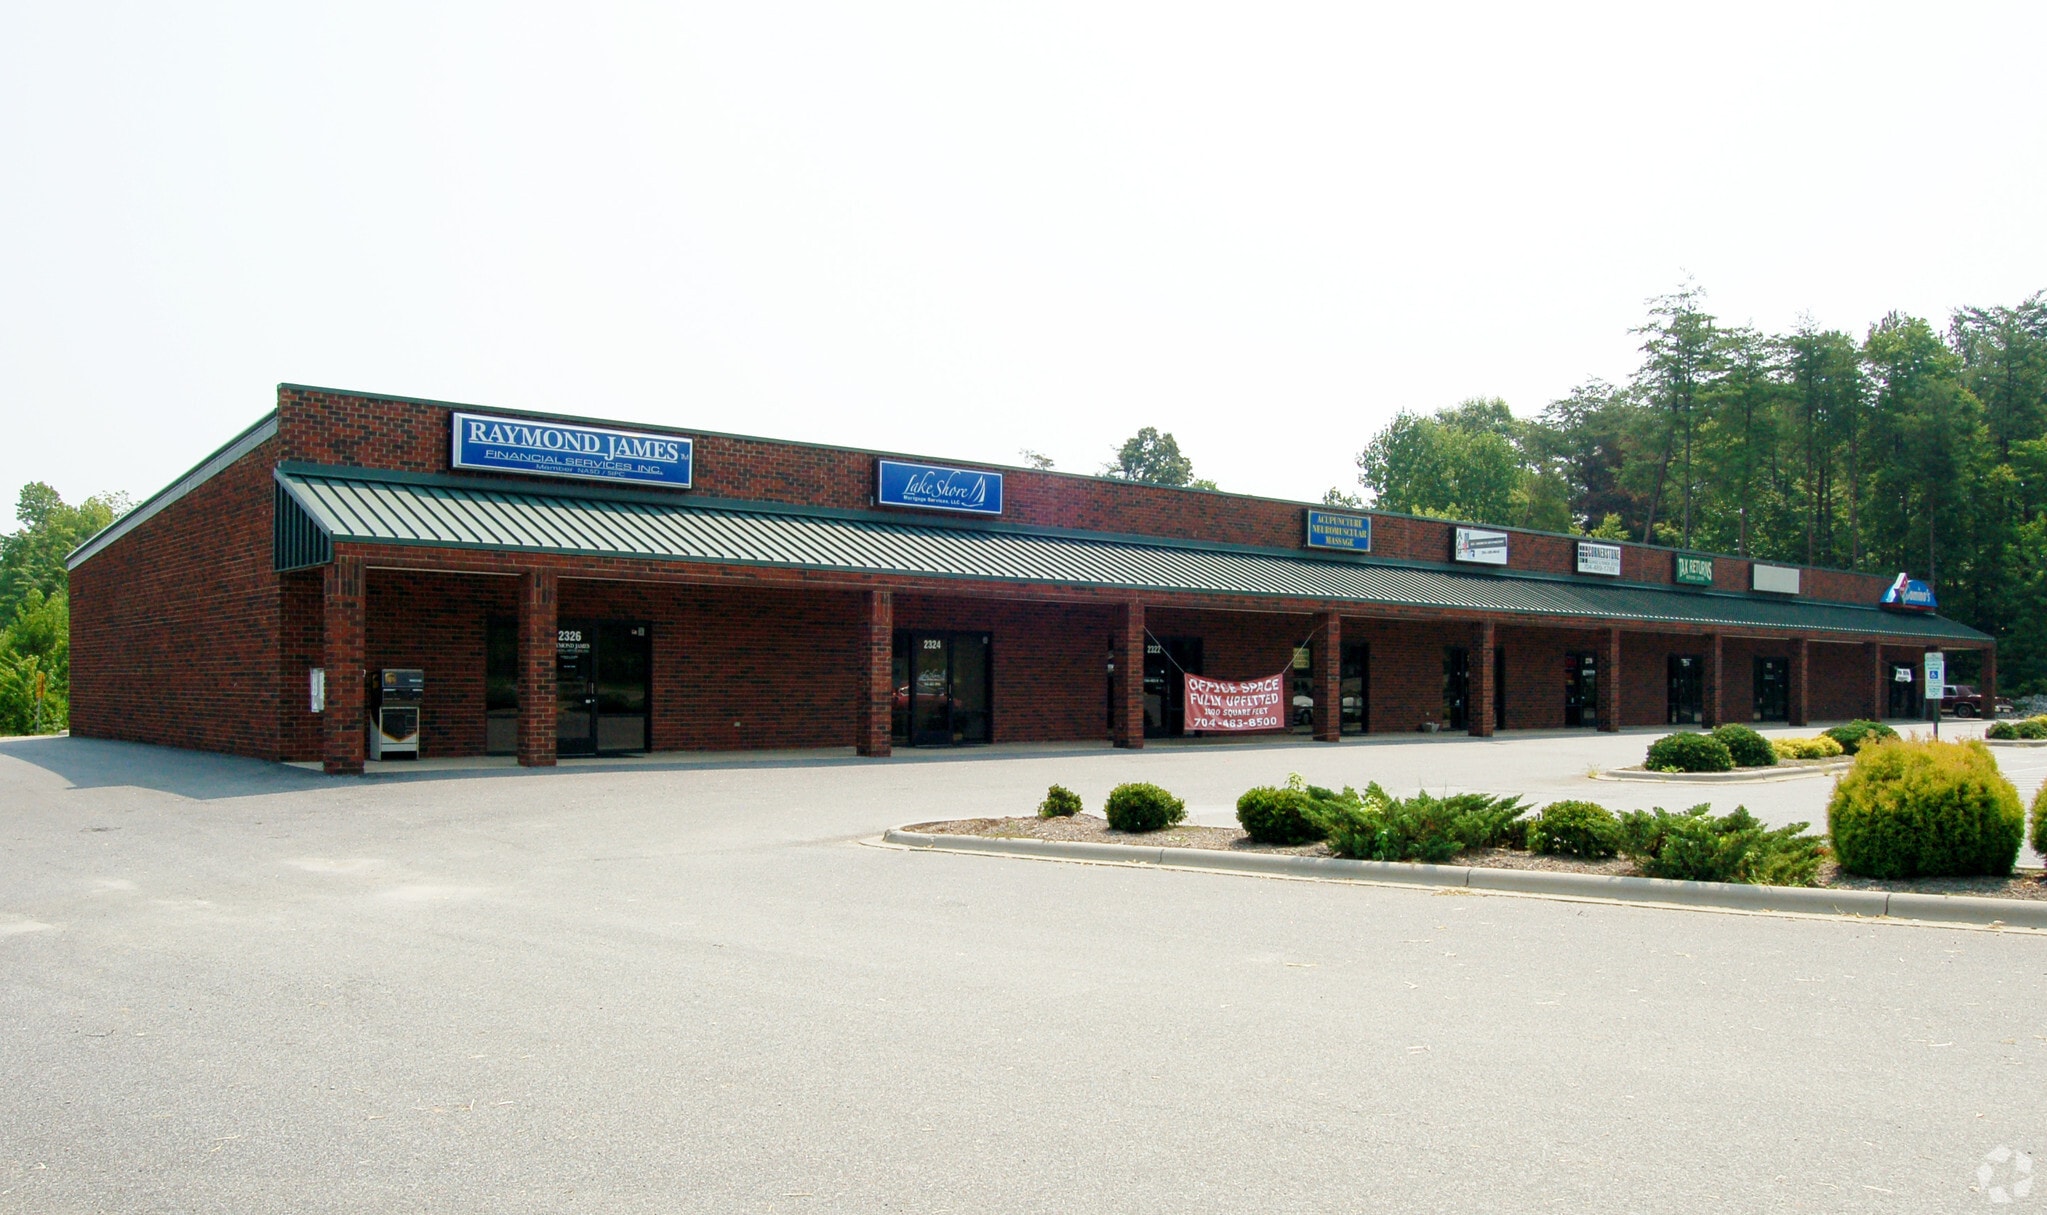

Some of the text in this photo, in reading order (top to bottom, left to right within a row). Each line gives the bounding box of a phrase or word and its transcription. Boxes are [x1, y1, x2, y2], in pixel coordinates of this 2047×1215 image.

[468, 422, 600, 452] RAYMOND
[604, 436, 678, 460] JAMES
[485, 450, 664, 475] FINANCIAL SERVICES INC.
[536, 464, 572, 472] Member
[902, 470, 968, 498] Lake Shore
[1317, 514, 1362, 528] ACUPUNCTURE
[1312, 524, 1366, 538] NEUROMUSCULAR
[1326, 536, 1354, 546] MASSAGE
[1588, 546, 1620, 560] CORNERSTONE
[1678, 558, 1712, 580] TAX RETURNS
[558, 630, 582, 642] 2326
[924, 640, 941, 650] 2324
[1188, 678, 1280, 693] OFFICE SPACE
[1190, 692, 1279, 706] FULLY UPFITTED
[1223, 708, 1250, 717] SQUARE
